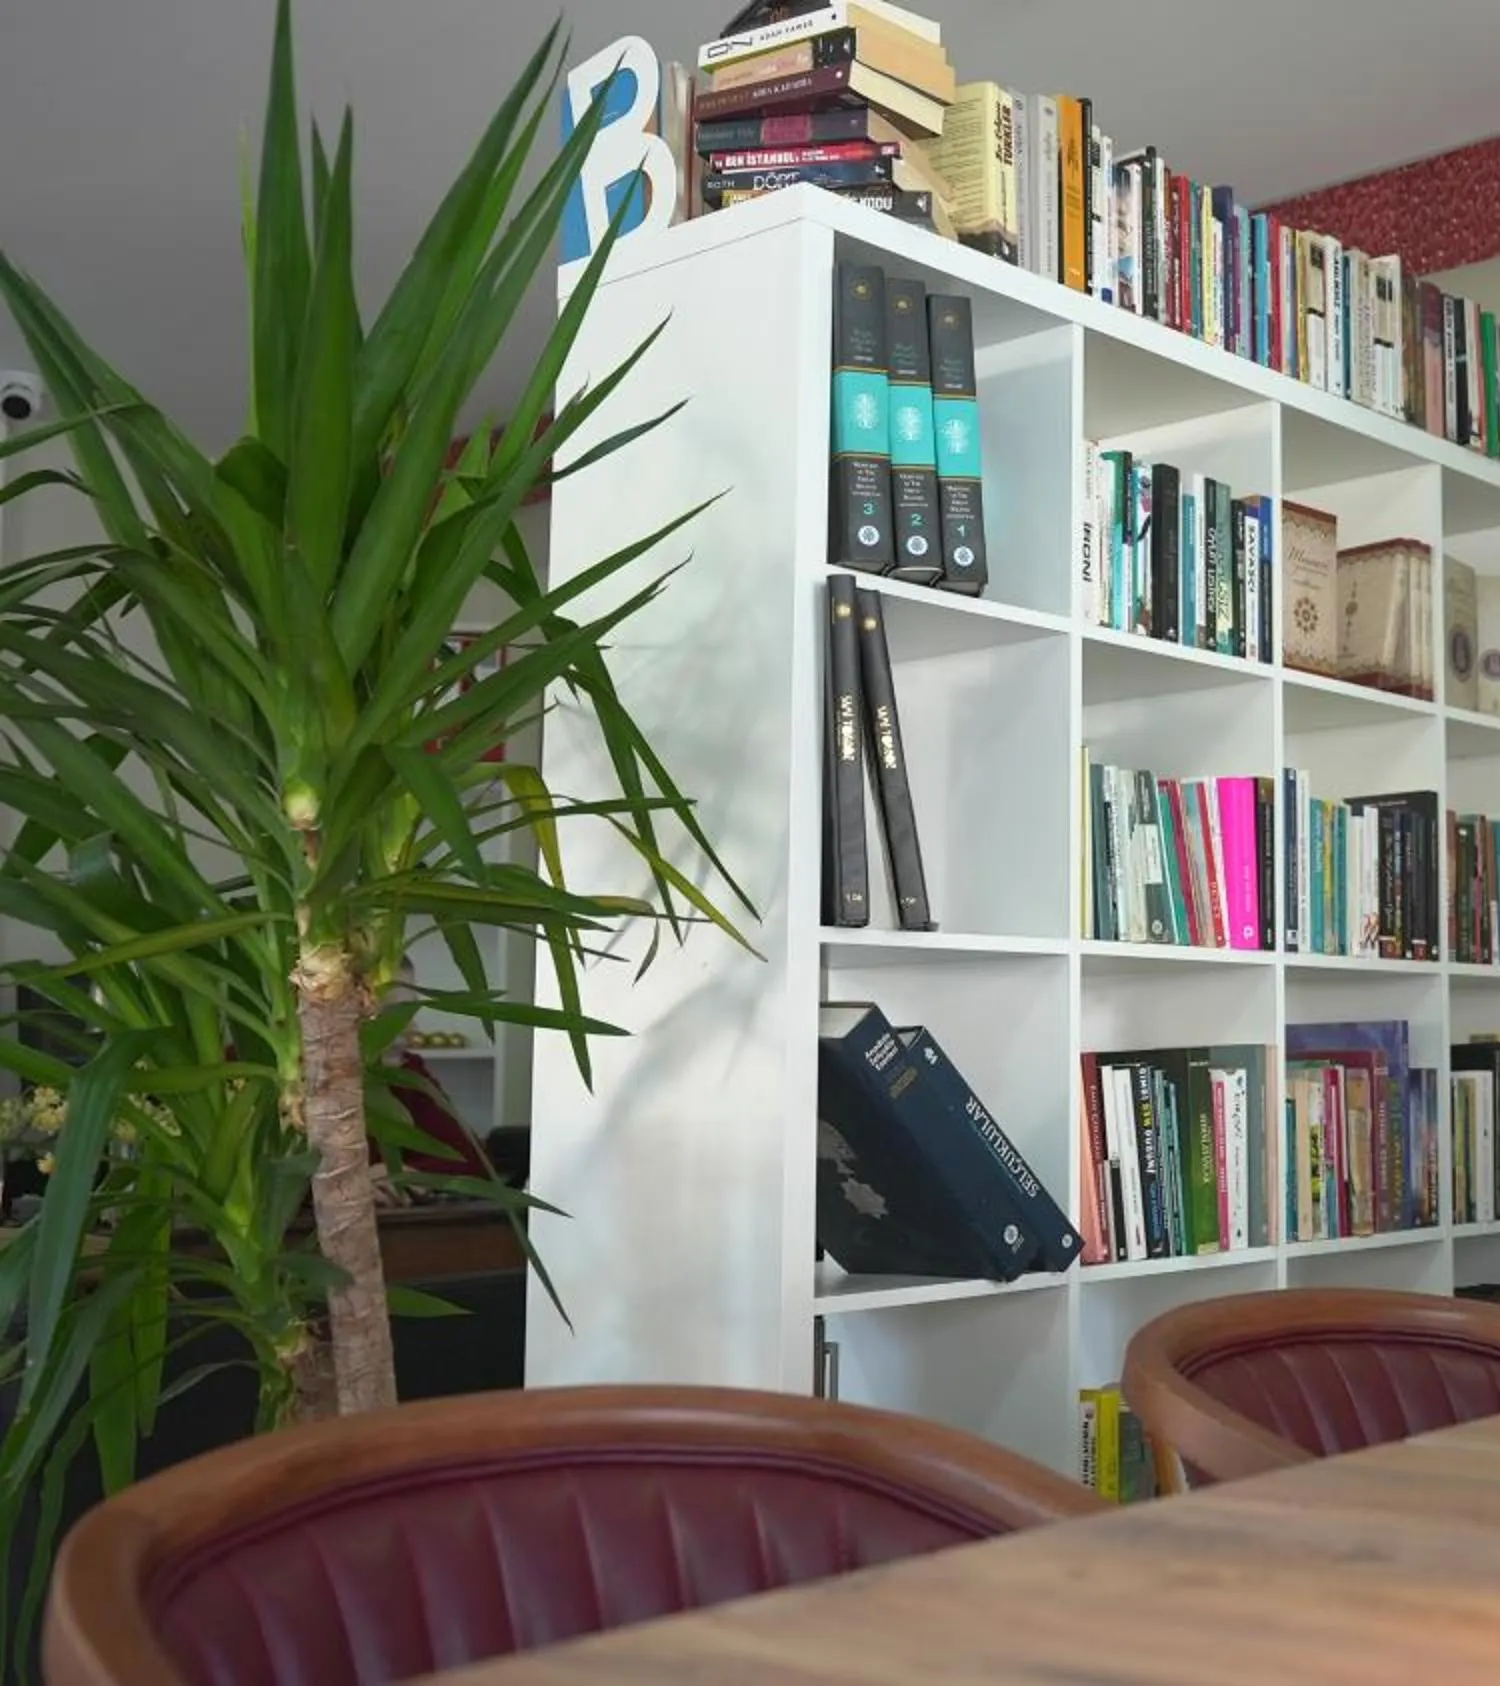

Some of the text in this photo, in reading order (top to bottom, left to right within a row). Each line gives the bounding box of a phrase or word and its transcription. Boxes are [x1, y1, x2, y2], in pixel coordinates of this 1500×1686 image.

[863, 503, 874, 515] 3
[911, 514, 922, 526] 2
[956, 525, 965, 537] 1
[965, 1096, 1040, 1198] SELÇUKLULAR
